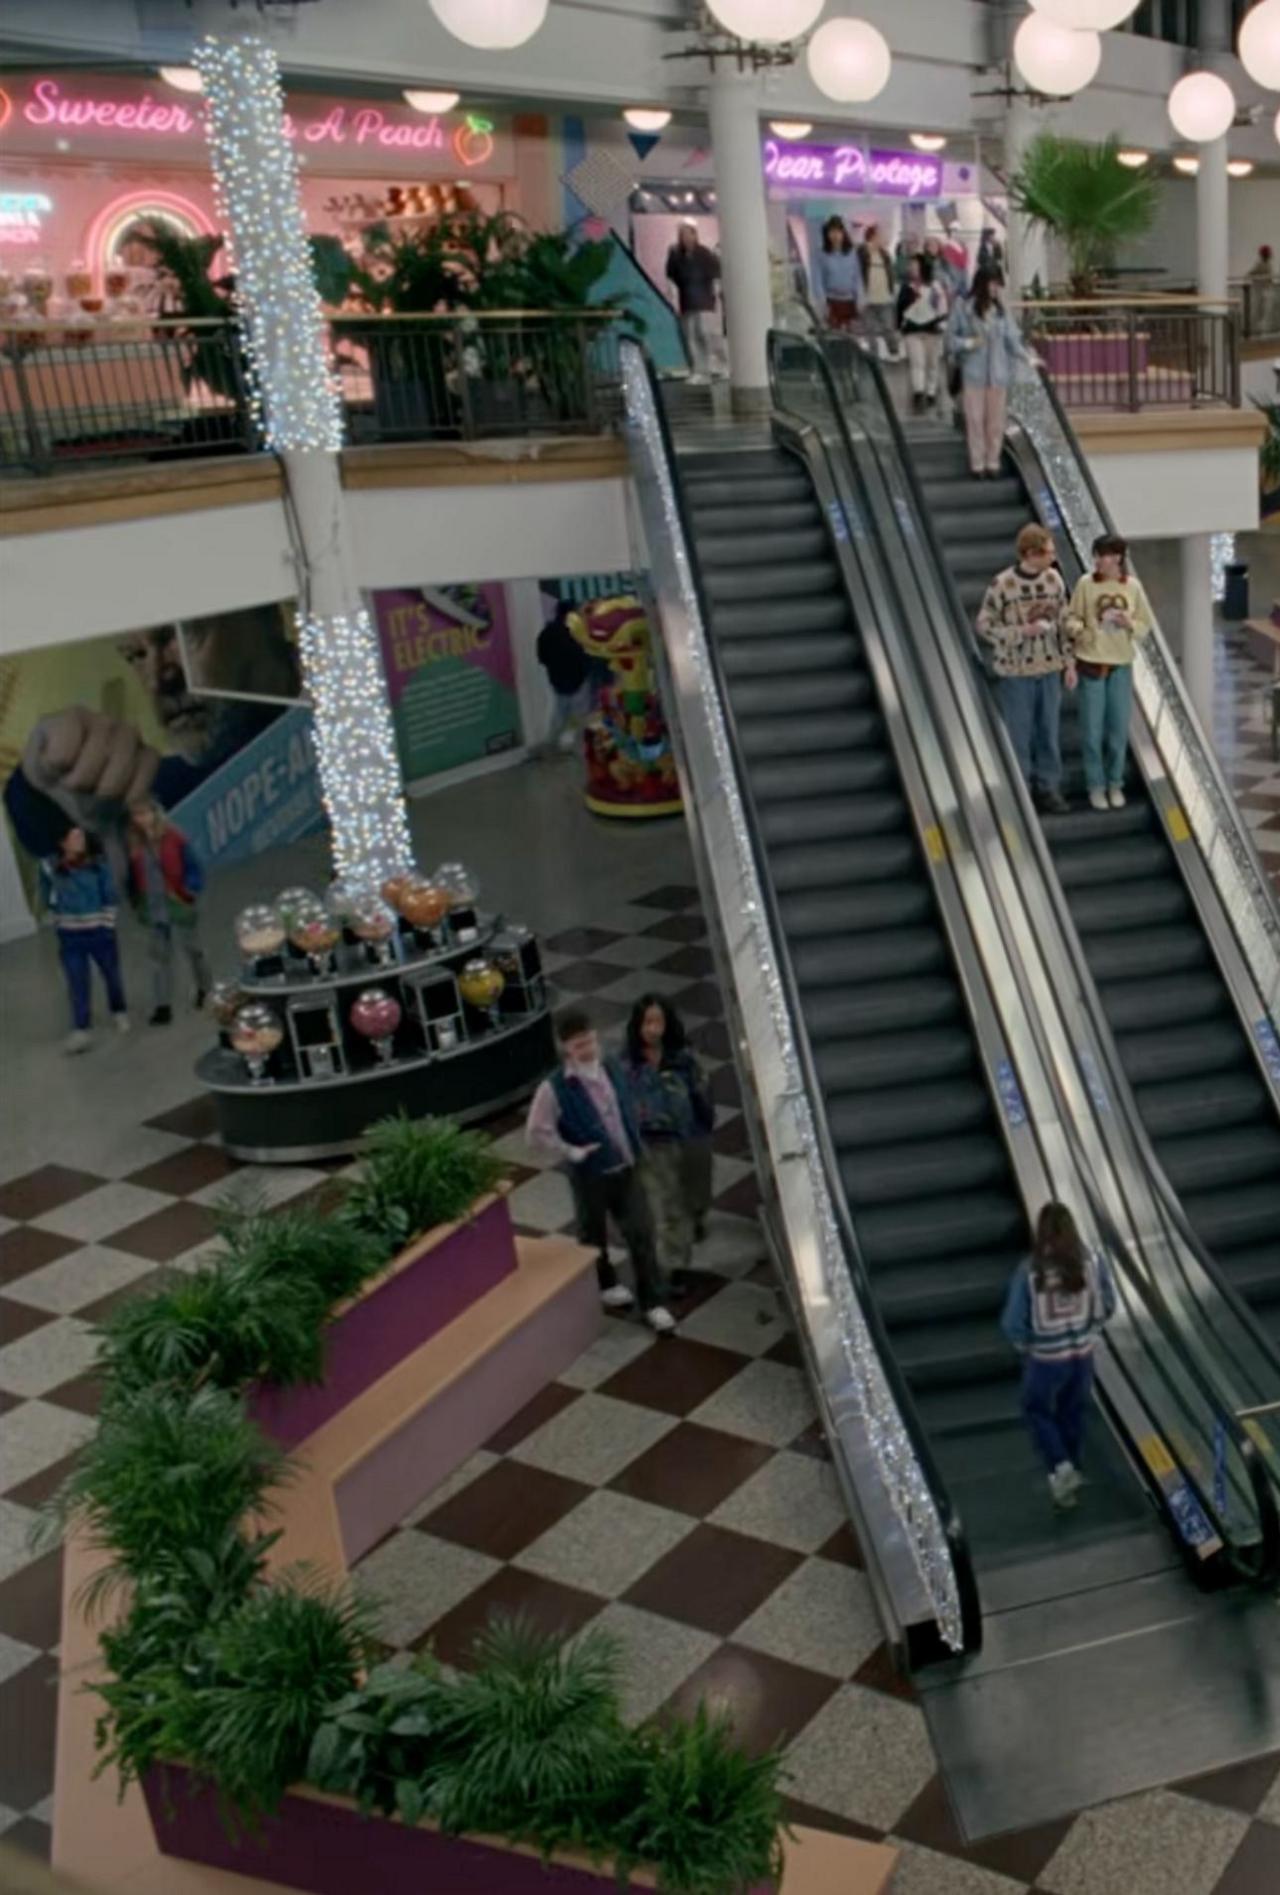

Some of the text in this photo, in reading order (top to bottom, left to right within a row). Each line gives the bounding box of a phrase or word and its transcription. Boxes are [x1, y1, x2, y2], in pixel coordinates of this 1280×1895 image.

[23, 79, 194, 136] Sweeter
[303, 106, 346, 142] A
[352, 109, 444, 149] Peach
[387, 603, 431, 640] IT'S
